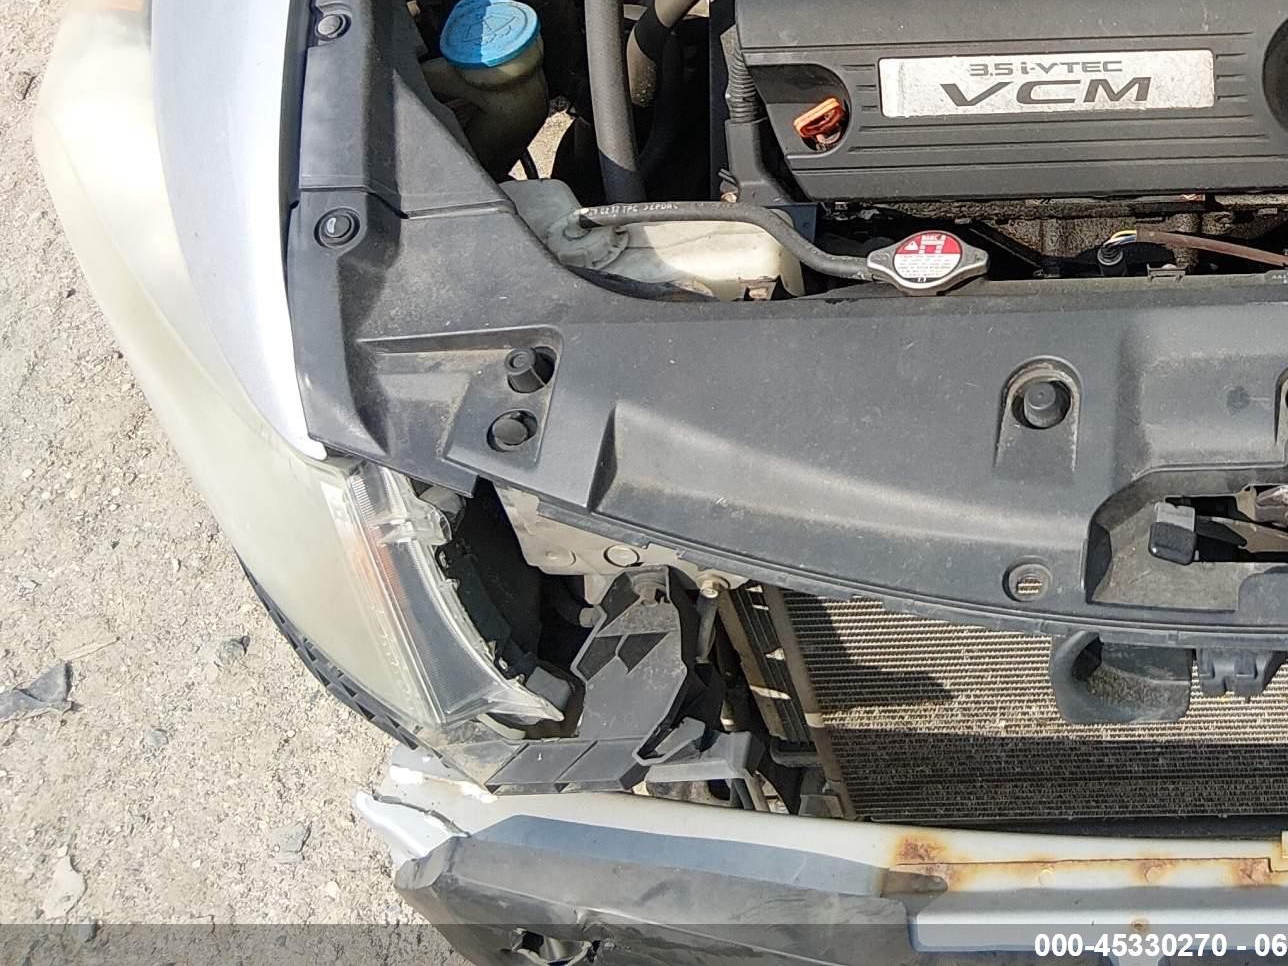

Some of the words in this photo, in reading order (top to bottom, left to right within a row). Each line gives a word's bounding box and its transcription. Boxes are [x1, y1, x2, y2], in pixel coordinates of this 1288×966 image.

[969, 62, 1014, 76] 3.5
[1020, 60, 1122, 74] i-VTEC
[939, 76, 1152, 107] VCM
